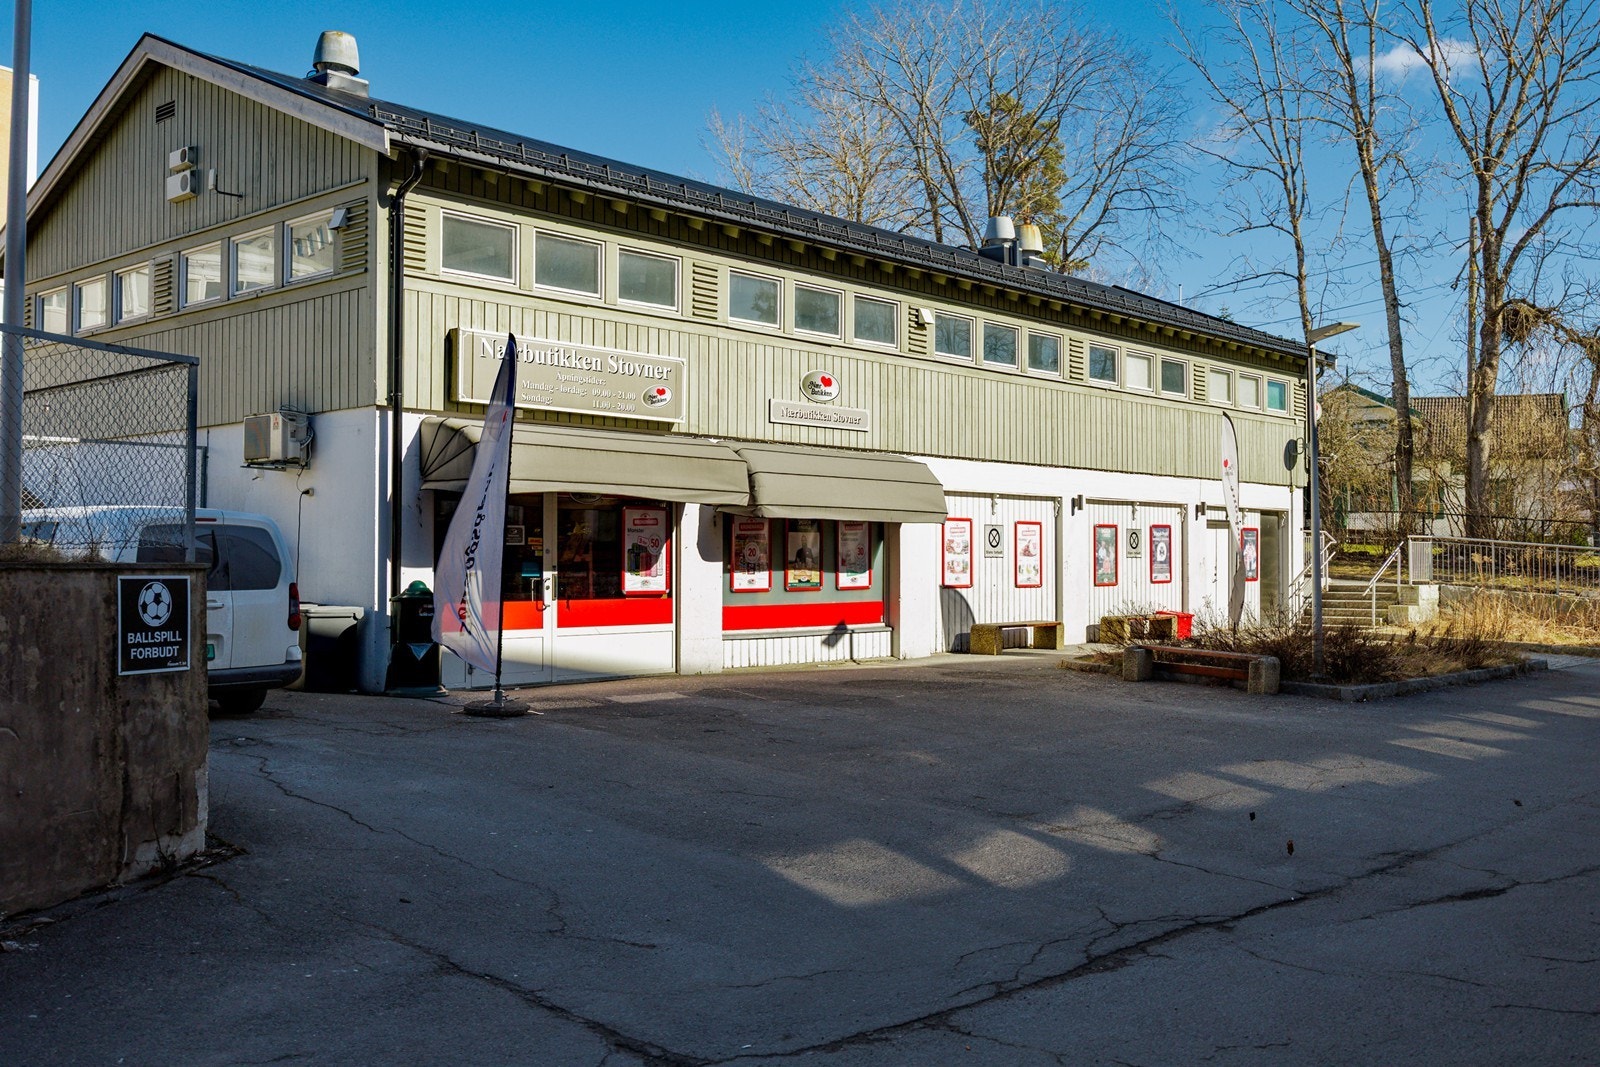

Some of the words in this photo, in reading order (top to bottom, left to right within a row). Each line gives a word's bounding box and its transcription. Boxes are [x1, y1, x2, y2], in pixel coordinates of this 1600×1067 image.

[608, 355, 671, 380] Stovner
[521, 380, 555, 394] Mandag
[592, 387, 612, 399] 09.00
[617, 390, 637, 401] 21.00
[781, 407, 831, 421] Nærbutikken
[834, 413, 861, 424] Stovner
[650, 537, 660, 549] 50
[748, 546, 757, 557] 20
[127, 631, 182, 643] BALLSPILL
[130, 646, 179, 659] FORBUDT
